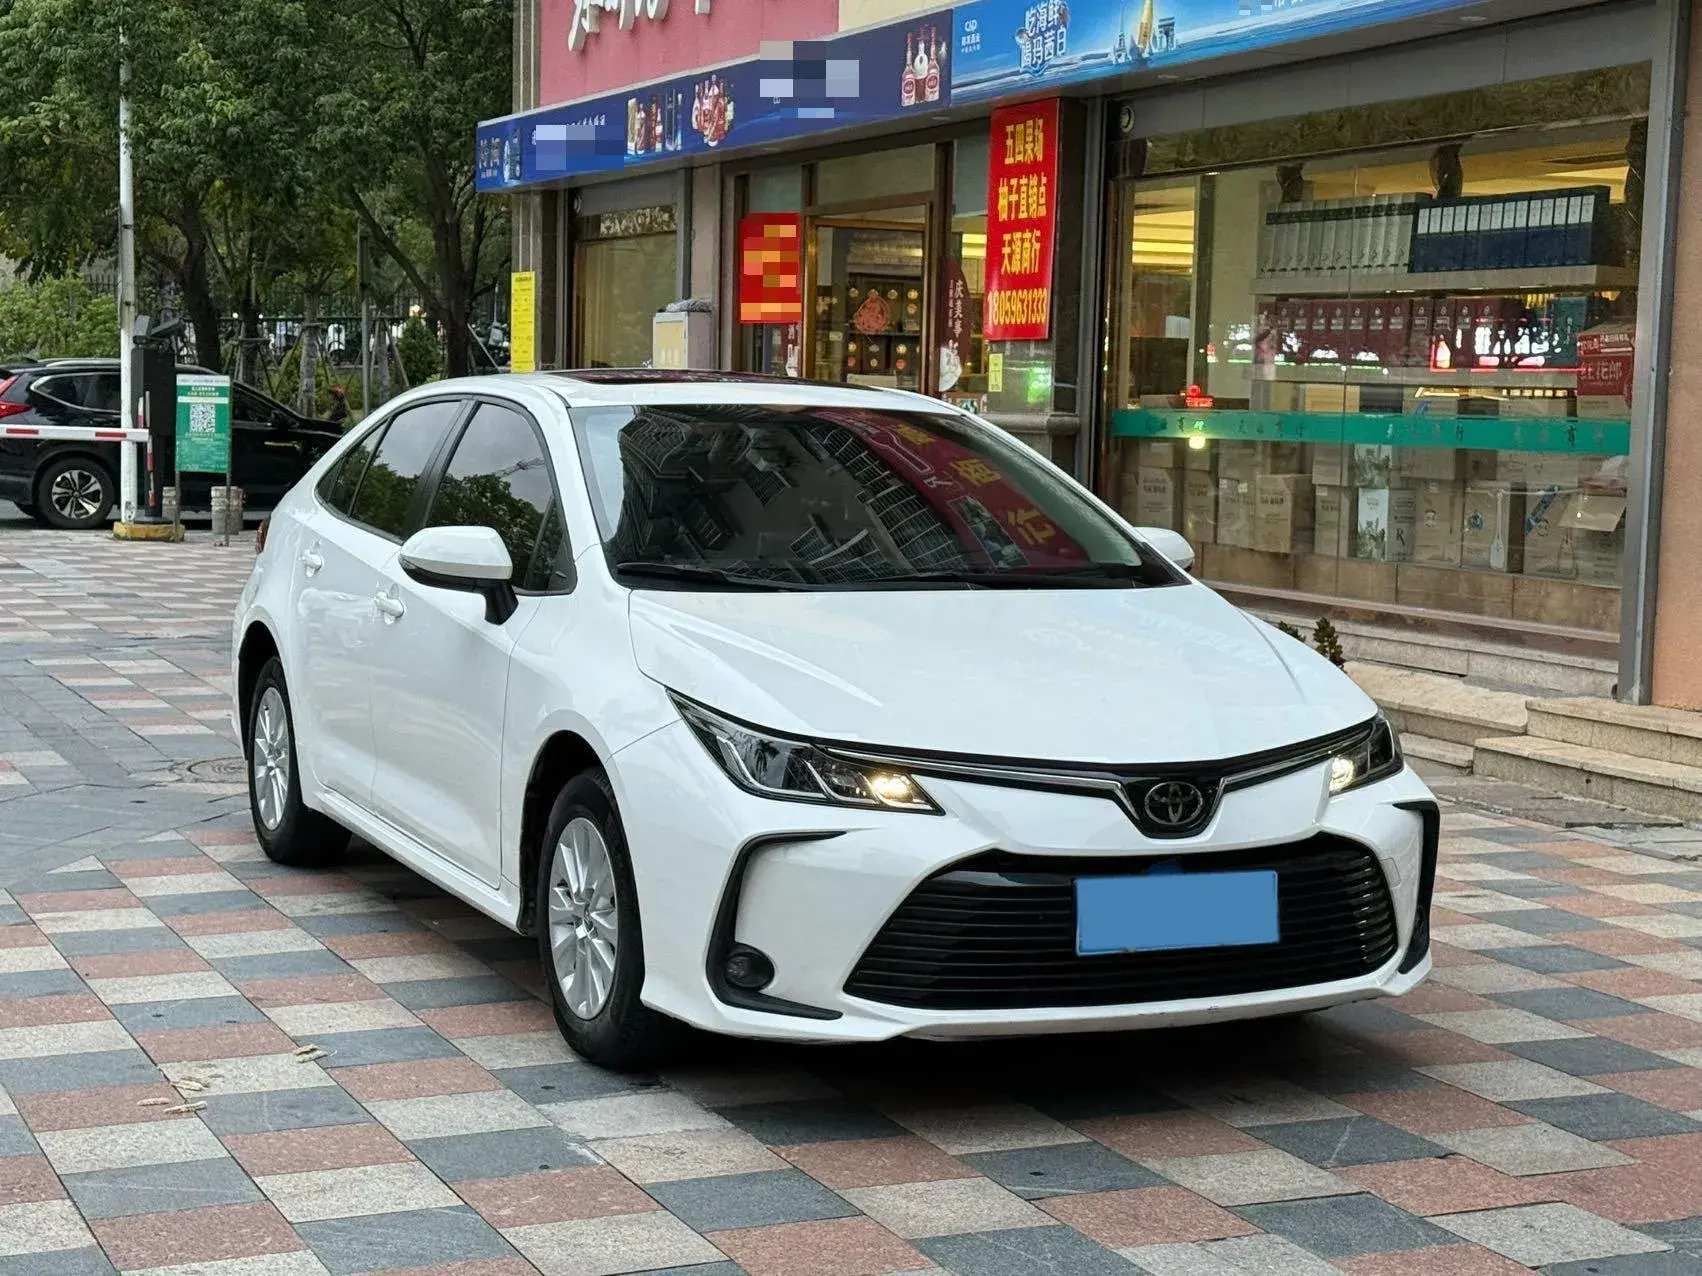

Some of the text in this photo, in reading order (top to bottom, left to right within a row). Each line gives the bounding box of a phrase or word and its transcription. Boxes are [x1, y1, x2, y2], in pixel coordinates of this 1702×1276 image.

[1004, 117, 1044, 164] 五四果场
[998, 172, 1047, 222] 柚子直销点
[1001, 228, 1041, 275] 天源商行
[987, 288, 1047, 325] 18059631333
